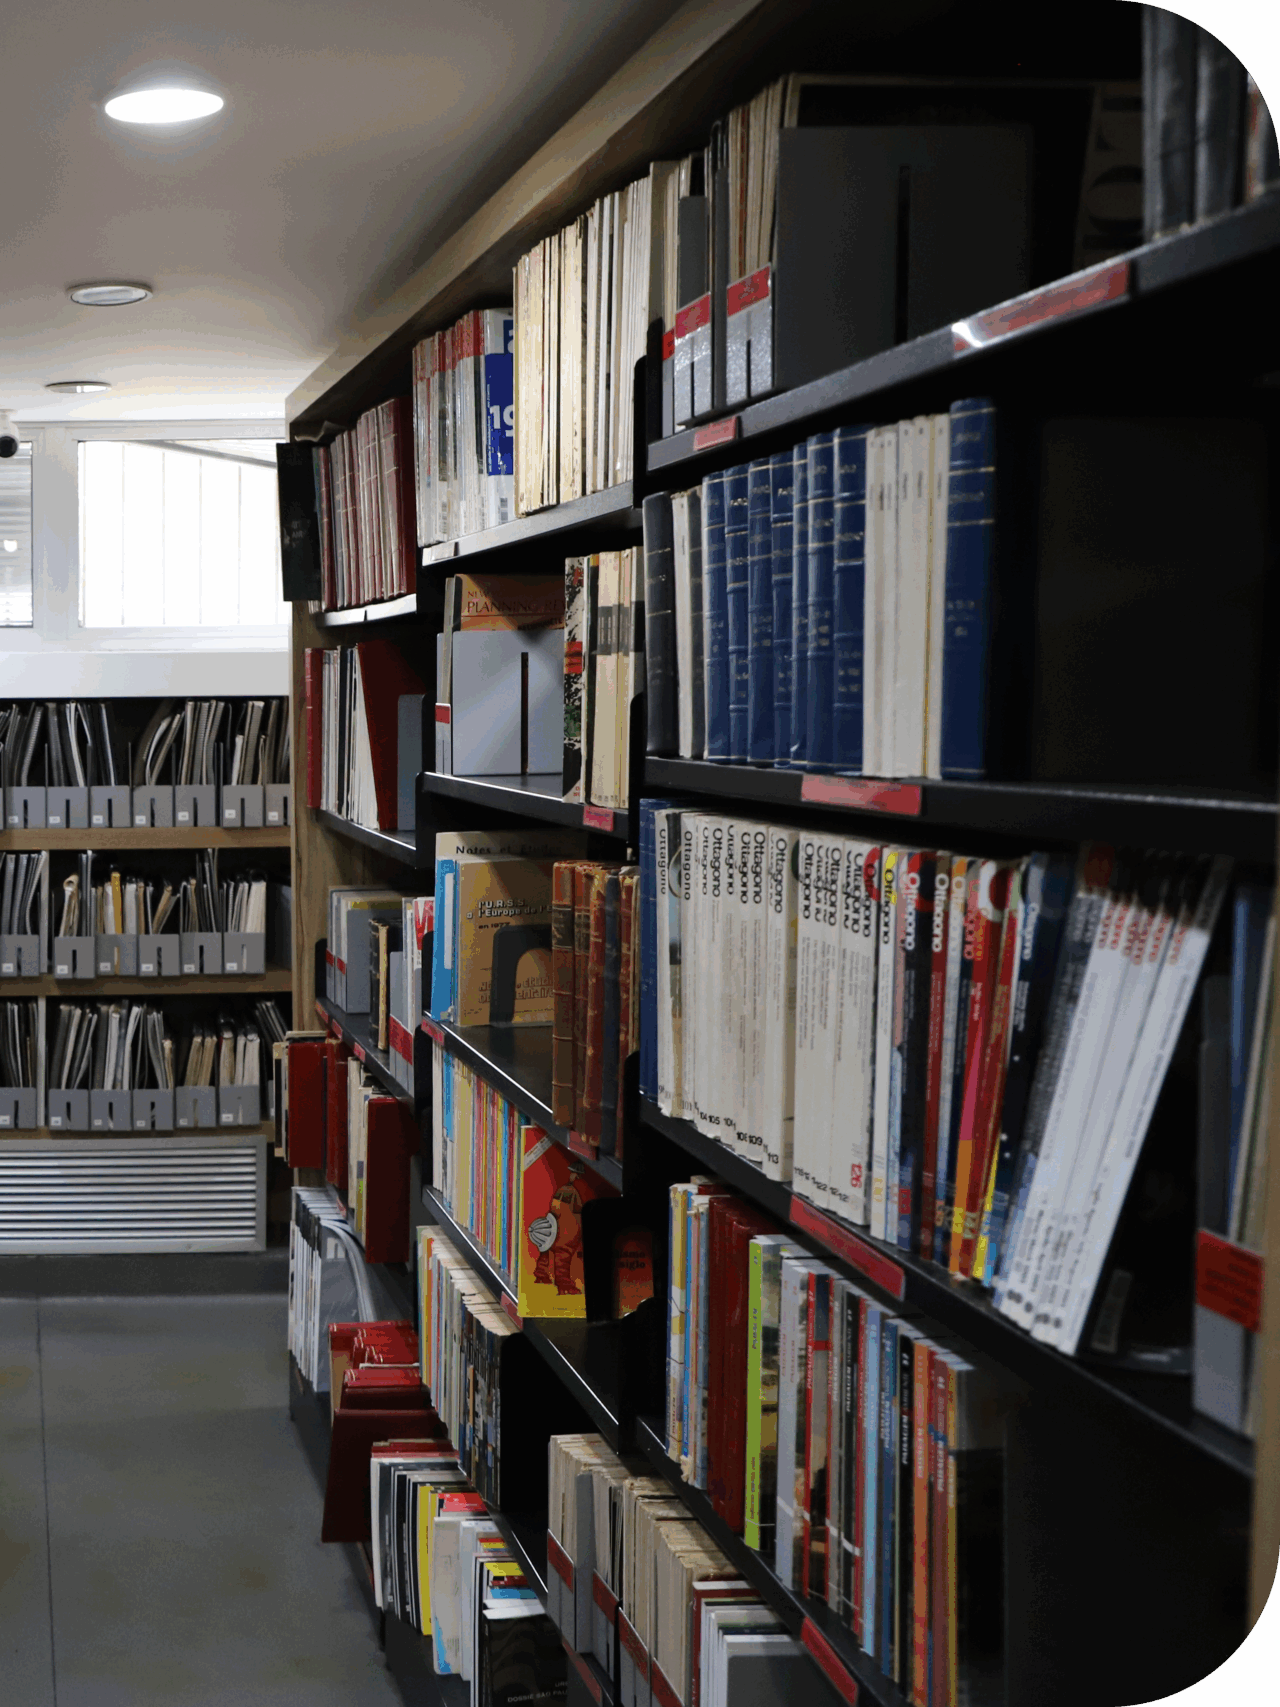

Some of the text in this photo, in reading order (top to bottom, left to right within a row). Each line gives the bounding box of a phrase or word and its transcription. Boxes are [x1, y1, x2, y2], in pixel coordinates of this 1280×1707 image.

[682, 830, 693, 901] Ottagono
[710, 827, 723, 898] Ottagono
[738, 832, 752, 905] Ottagono
[751, 831, 766, 905] Ottagono
[773, 837, 788, 914] Ottagono
[799, 842, 815, 920] Ottagono
[708, 1114, 721, 1126] 105
[748, 1133, 763, 1147] 109
